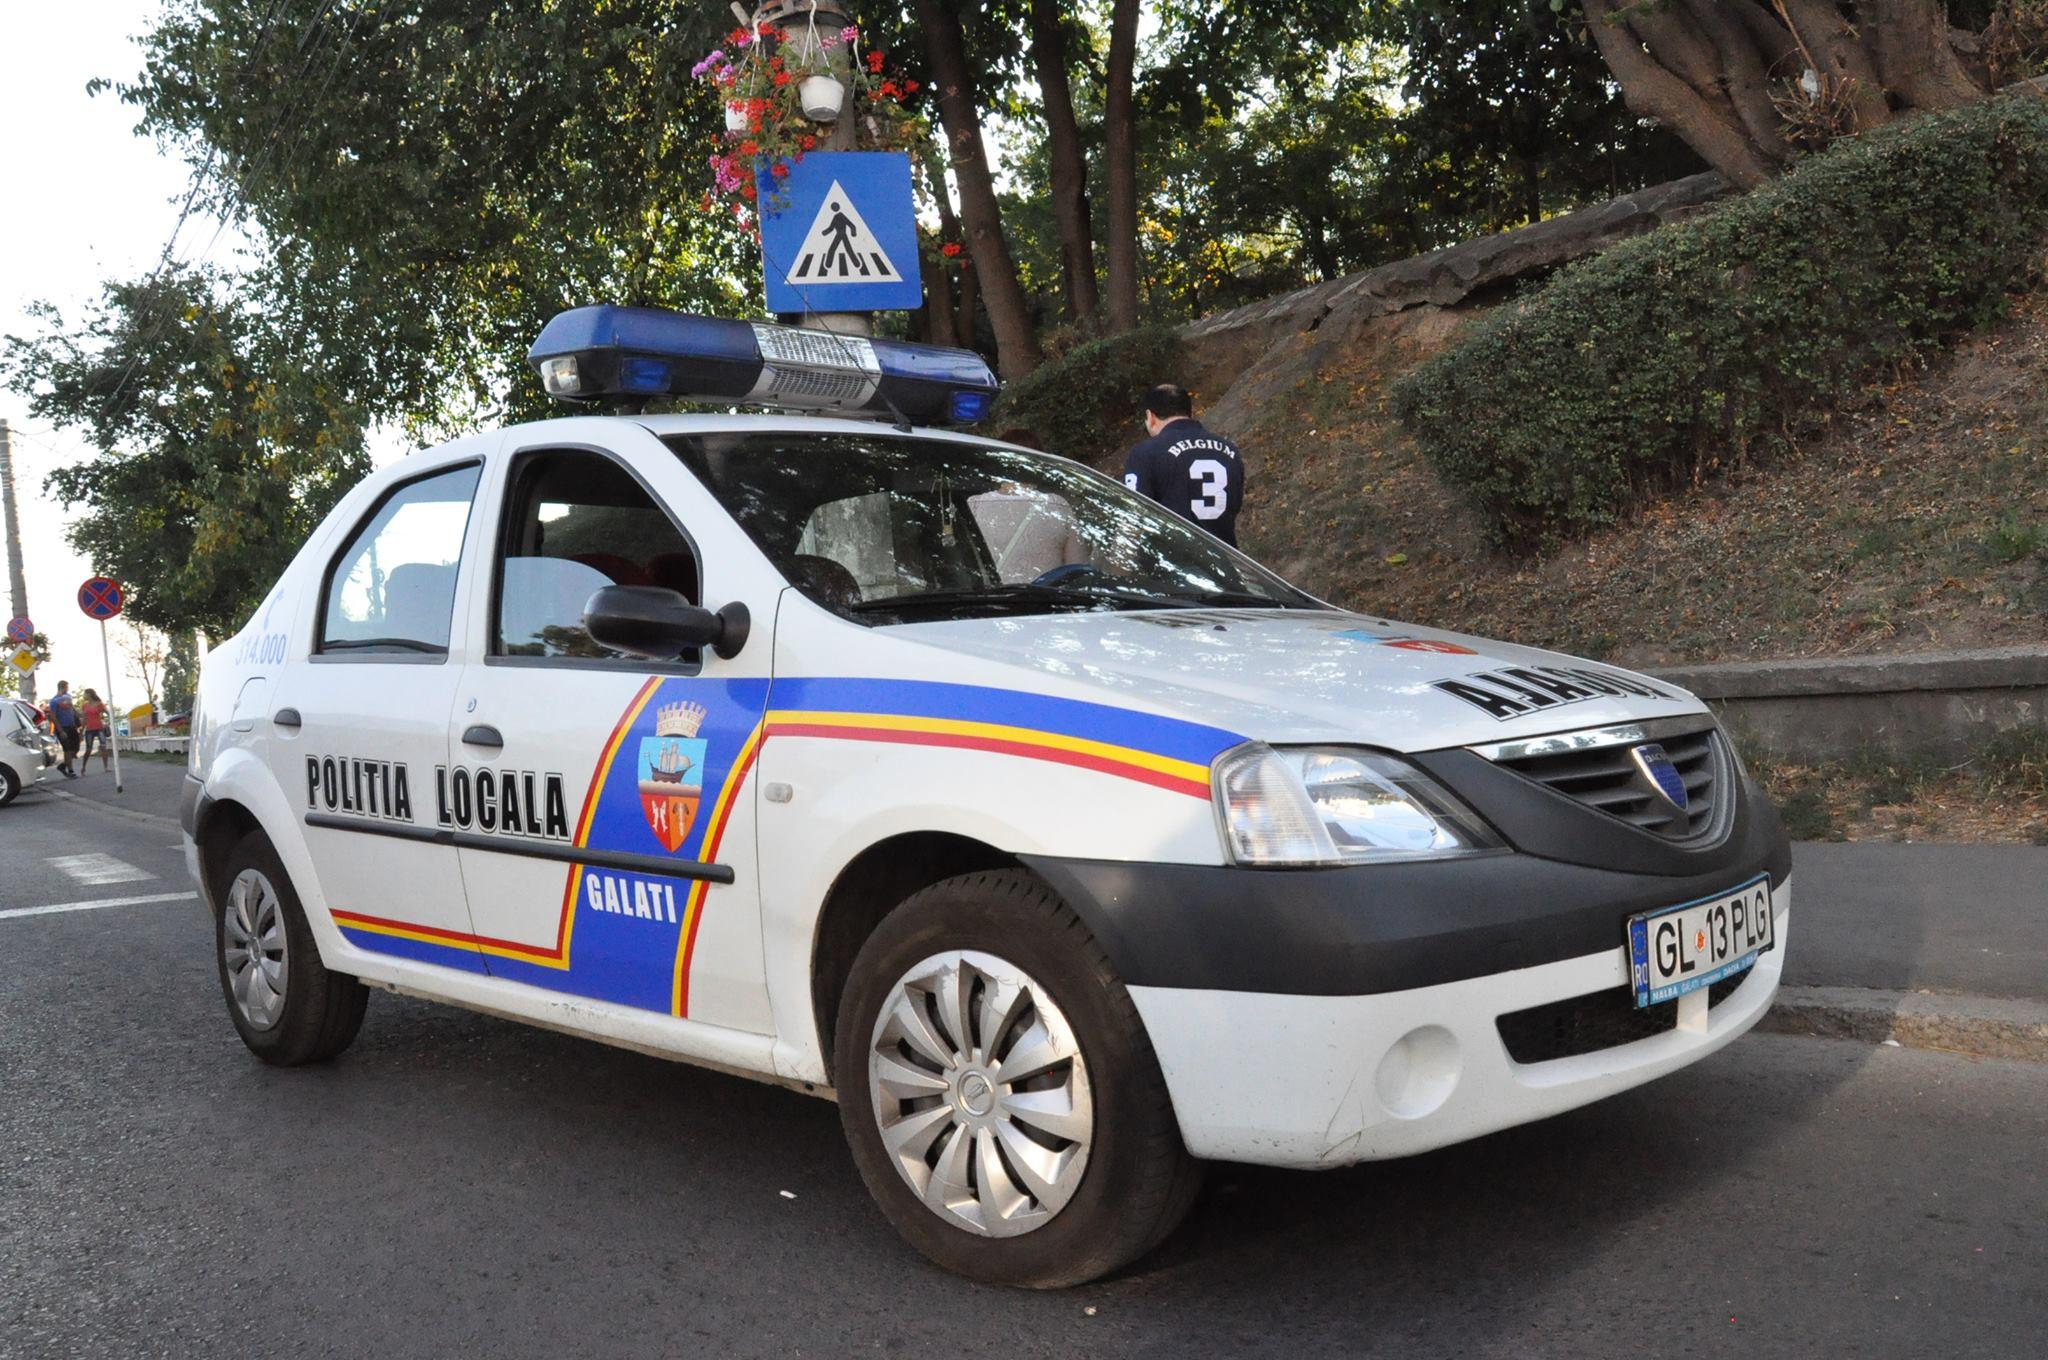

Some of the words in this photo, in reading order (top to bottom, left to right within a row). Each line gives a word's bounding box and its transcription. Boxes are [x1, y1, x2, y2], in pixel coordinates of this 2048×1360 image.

[1168, 438, 1236, 460] BELGIUM
[1189, 459, 1228, 520] 3
[305, 754, 414, 823] POLITIA
[435, 765, 572, 842] LOCALA
[586, 873, 677, 923] GALATI
[1656, 918, 1695, 977] GL
[1706, 905, 1728, 962] 13
[1731, 890, 1767, 953] PLG
[1635, 962, 1648, 987] RO
